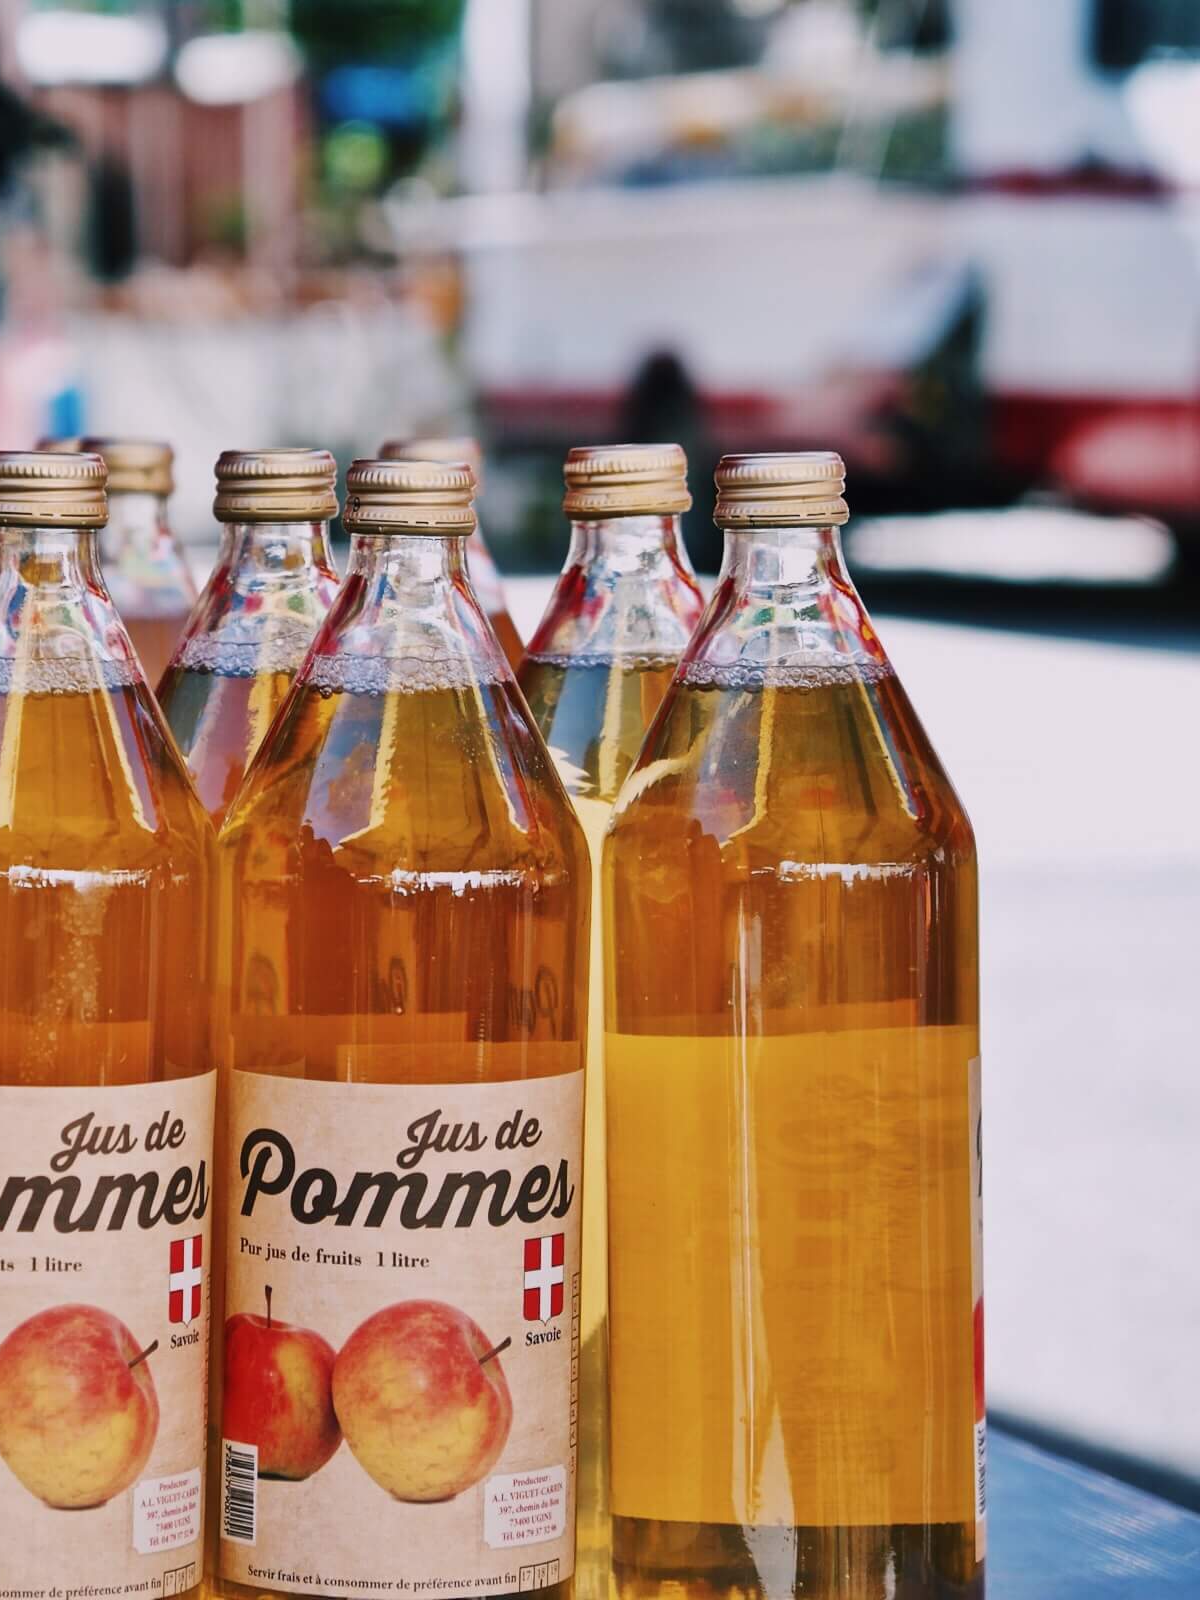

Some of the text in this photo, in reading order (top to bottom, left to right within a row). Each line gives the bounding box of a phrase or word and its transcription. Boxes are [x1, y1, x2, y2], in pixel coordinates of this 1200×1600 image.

[49, 1110, 187, 1173] Jus de
[396, 1109, 543, 1169] Jus de
[239, 1127, 575, 1230] Pommes
[29, 1256, 38, 1272] 1
[45, 1256, 83, 1273] litre
[239, 1236, 430, 1269] Pur jus de fruits 1 litre
[170, 1330, 200, 1350] Savoie
[524, 1326, 562, 1347] Savoie
[515, 1502, 540, 1513] chemin
[48, 1587, 66, 1599] de
[65, 1583, 122, 1600] préférence
[124, 1581, 150, 1593] avant
[151, 1577, 162, 1589] fin
[247, 1564, 276, 1581] Servir
[278, 1569, 300, 1584] frais
[303, 1575, 313, 1585] et
[315, 1573, 322, 1586] à
[324, 1577, 393, 1590] consommer
[396, 1578, 410, 1591] de
[413, 1575, 472, 1593] préférence
[474, 1574, 503, 1587] avant
[504, 1571, 517, 1584] fin
